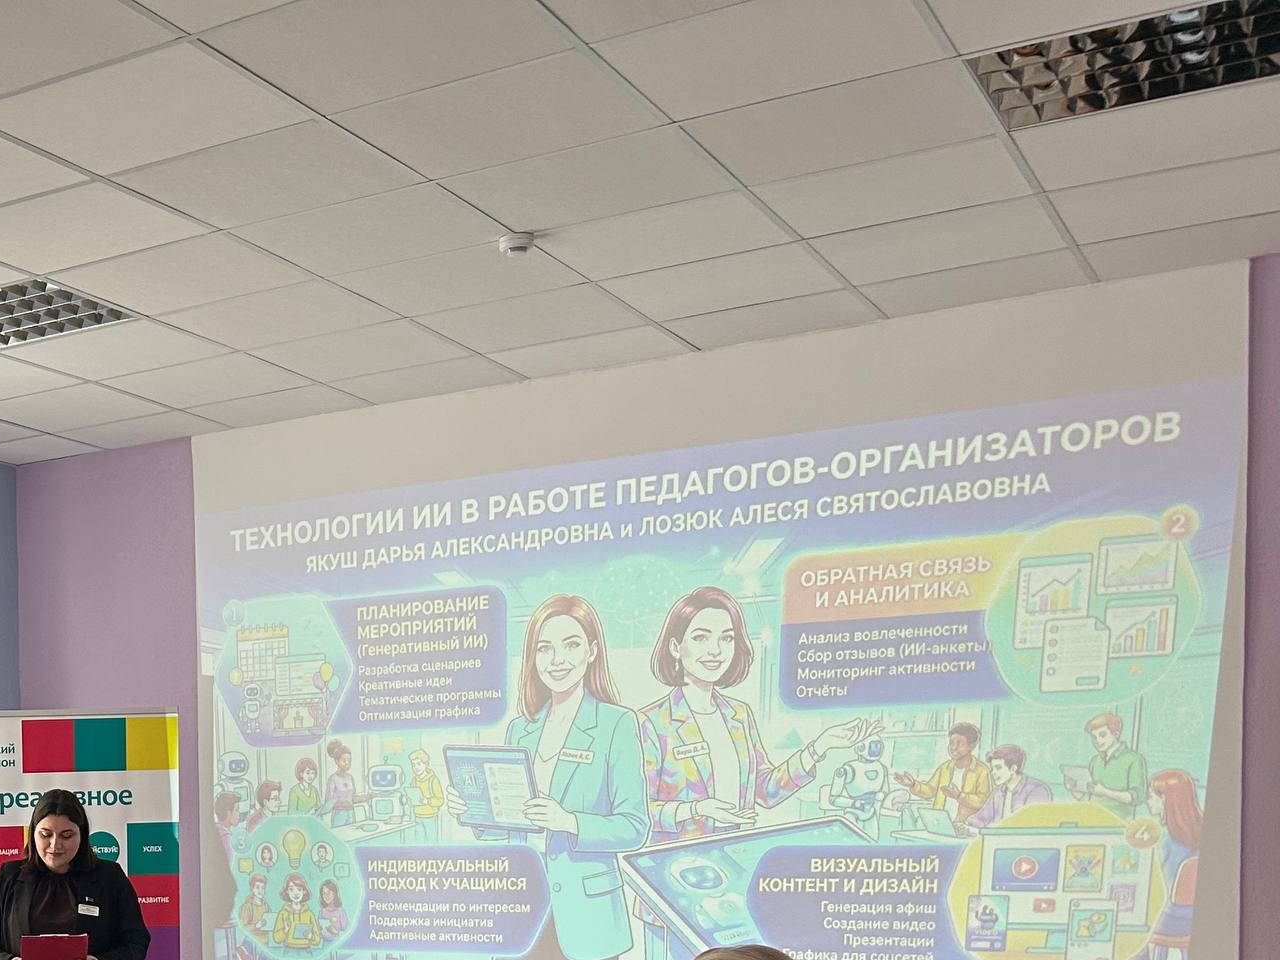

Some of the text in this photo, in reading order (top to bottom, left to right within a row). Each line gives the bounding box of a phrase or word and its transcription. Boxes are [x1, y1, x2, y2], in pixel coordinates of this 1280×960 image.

[230, 411, 1182, 552] ТЕХНОЛОГИИ ИИ В РАБОТЕ ПЕДАГОГОВ-ОРГАНИЗАТОРОВ
[305, 472, 1051, 575] ЯКУШ ДАРЬЯ АЛЕКСАНДРОВНА и ЛОЗЮК АЛЕСЯ СВЯТОСЛАВОВНА
[1170, 514, 1186, 534] 2
[800, 555, 991, 588] ОБРАТНАЯ СВЯЗЬ
[815, 581, 970, 609] И АНАЛИТИКА
[357, 595, 489, 621] ПЛАНИРОВАНИЕ
[357, 613, 477, 640] МЕРОПРИЯТИЙ
[798, 624, 968, 645] Анализ вовлеченности
[357, 634, 488, 659] (Генеративный ИИ)
[797, 649, 832, 664] Сбор
[836, 646, 895, 660] отзывов
[358, 658, 481, 677] Разработка сценариев
[797, 660, 975, 681] Мониторинг активности
[358, 677, 453, 693] Креативные идеи
[796, 683, 848, 698] Отчёты
[359, 689, 501, 707] Тематические программы
[359, 705, 480, 722] Оптимизация графика
[1135, 825, 1152, 842] 4
[143, 845, 163, 853] УСПЕХ
[368, 857, 509, 874] ИНДИВИДУАЛЬНЫЙ
[810, 855, 940, 873] ВИЗУАЛЬНЫЙ
[368, 877, 527, 893] ПОДХОД К УЧАЩИМСЯ
[759, 876, 938, 896] КОНТЕНТ И ДИЗАЙН
[137, 896, 170, 904] РАЗВИТИЕ
[369, 900, 531, 915] Рекомендации по интересам
[821, 901, 937, 916] Генерация афиш
[369, 915, 494, 929] Поддержка инициатив
[823, 917, 936, 932] Создание видео
[369, 929, 503, 944] Адаптивные активности
[843, 934, 935, 948] Презентации
